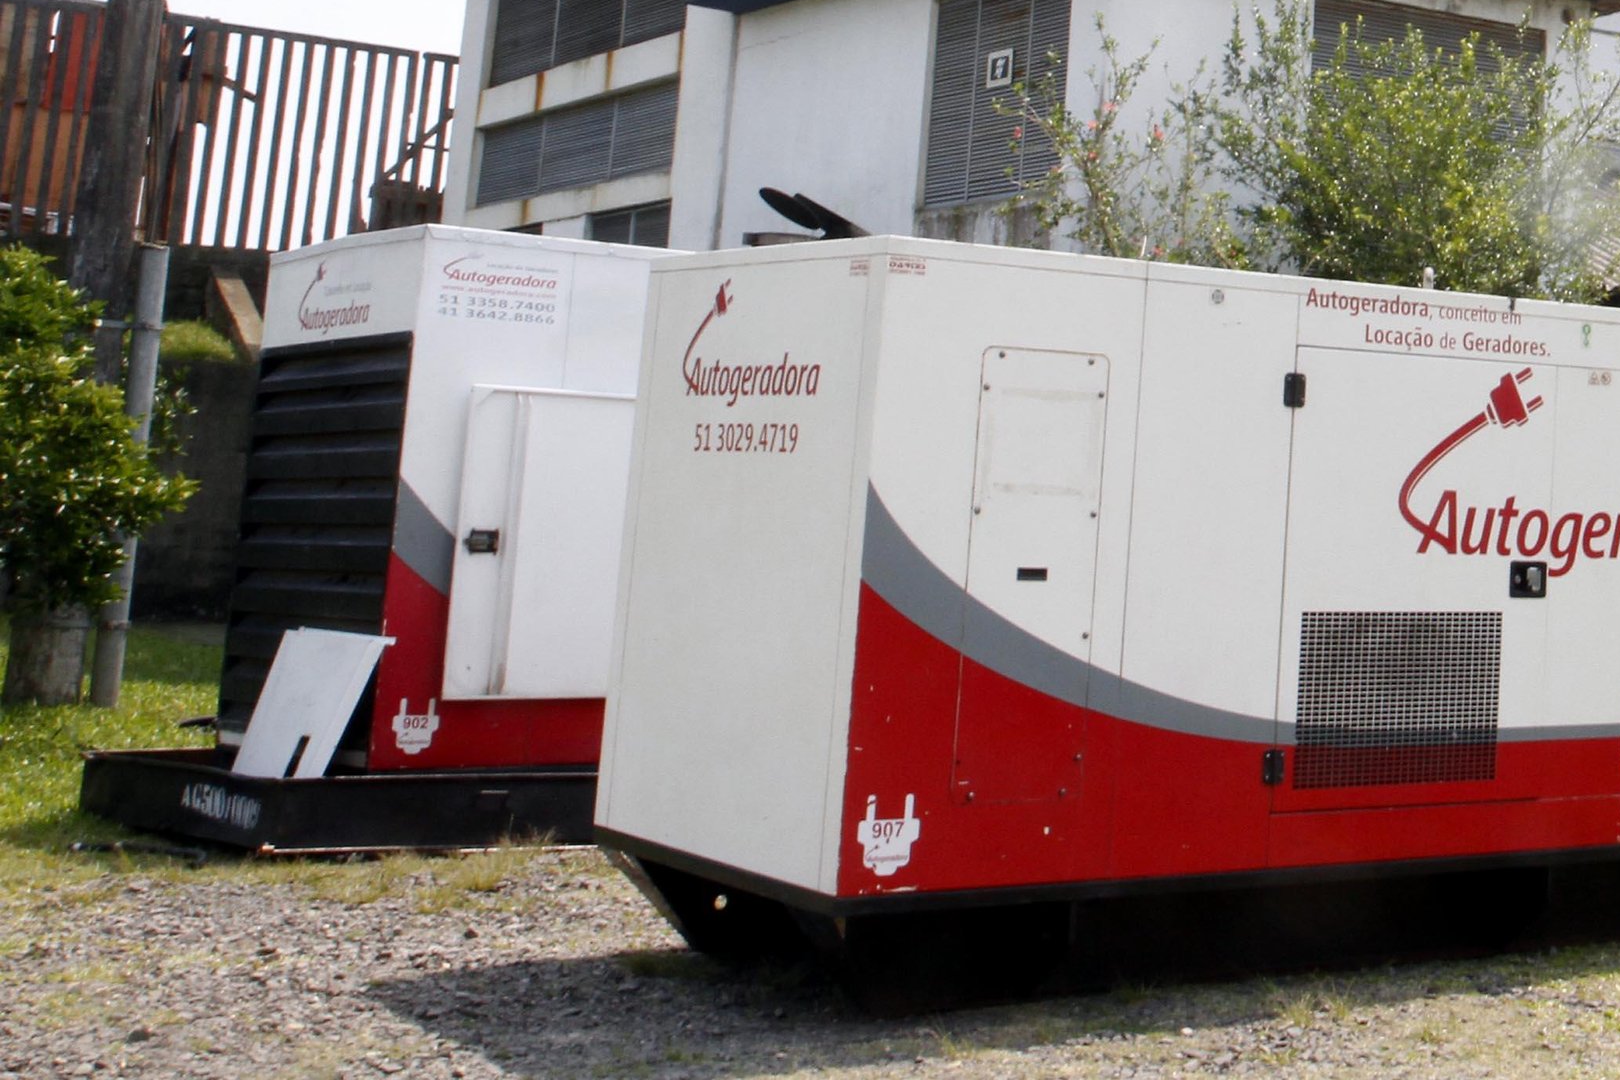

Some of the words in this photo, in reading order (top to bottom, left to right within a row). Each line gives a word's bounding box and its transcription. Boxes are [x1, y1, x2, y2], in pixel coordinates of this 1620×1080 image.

[449, 269, 558, 288] Autogeradora
[439, 294, 459, 305] 51
[301, 300, 370, 335] Autogeradora
[1439, 304, 1497, 324] conceito
[1501, 311, 1522, 325] em
[1365, 323, 1434, 350] Locação
[1440, 332, 1457, 350] de
[1463, 332, 1551, 357] Geradores.
[686, 352, 821, 407] Autogeradora
[694, 423, 711, 452] 51
[716, 423, 799, 453] 3029.4719
[403, 716, 429, 729] 902
[872, 821, 905, 839] 907
